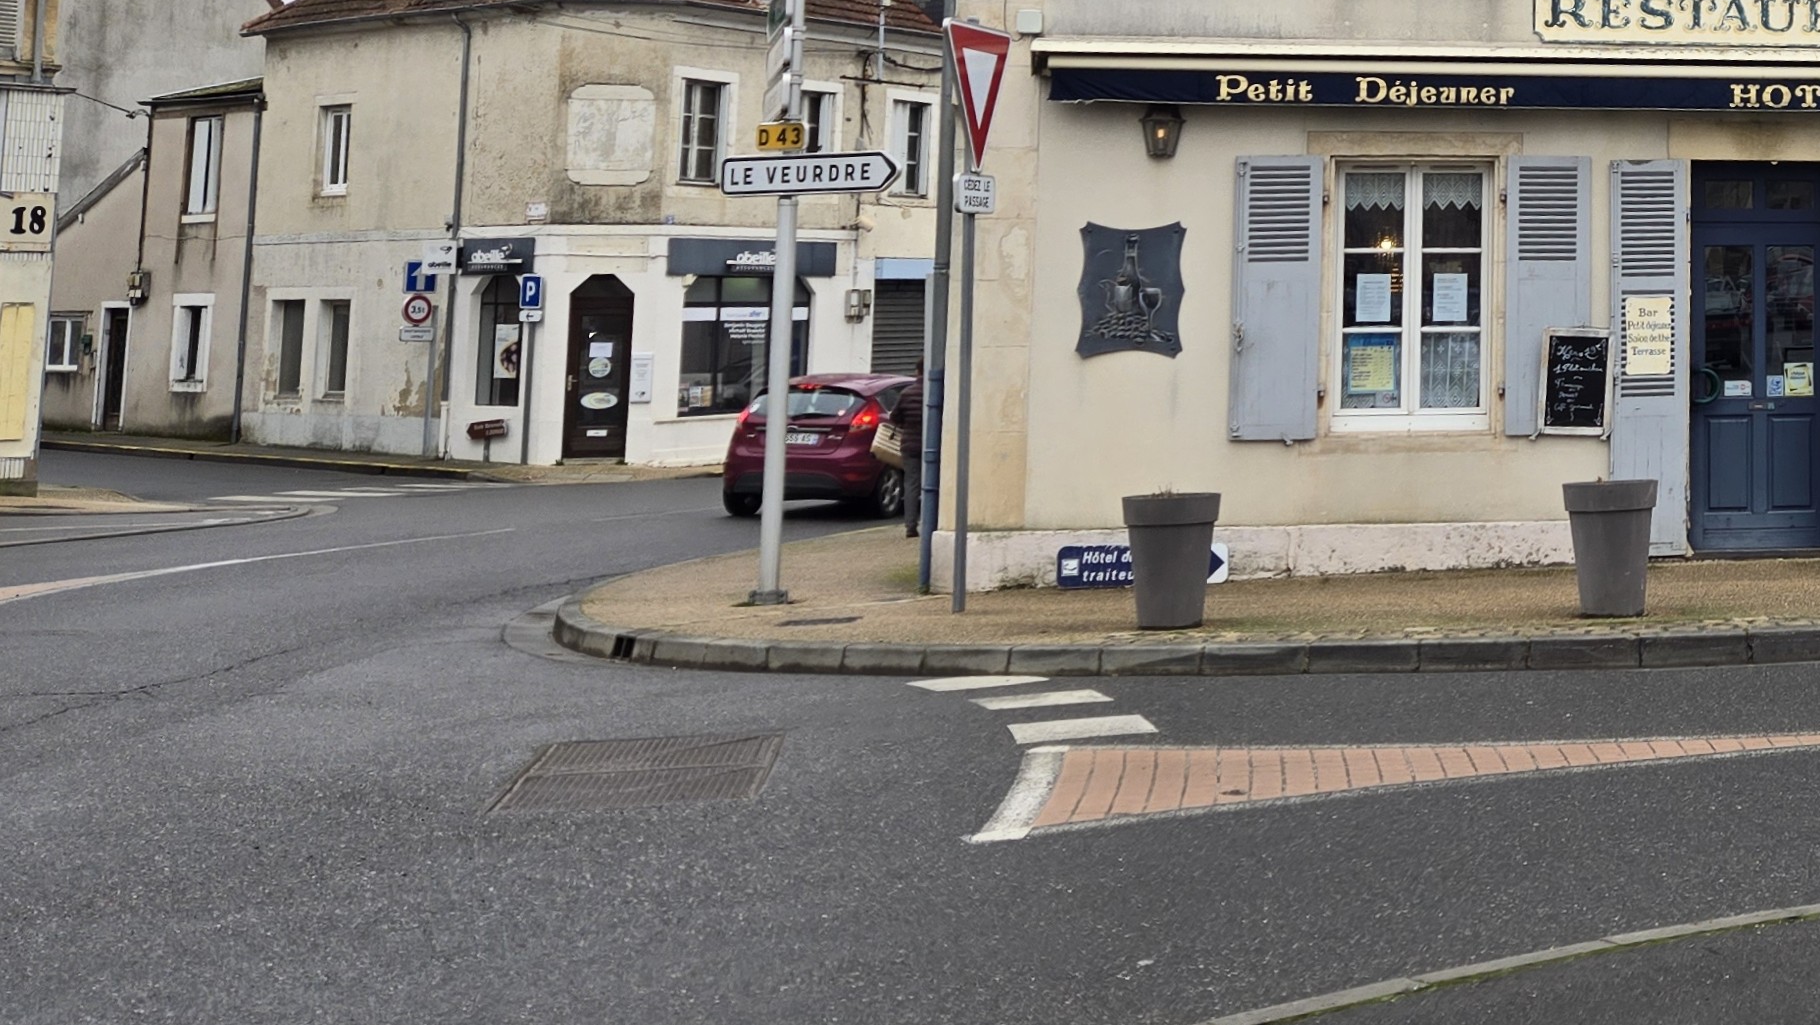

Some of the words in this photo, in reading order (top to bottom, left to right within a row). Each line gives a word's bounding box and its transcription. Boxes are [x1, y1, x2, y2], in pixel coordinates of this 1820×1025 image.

[1215, 74, 1313, 102] Petit
[1355, 76, 1515, 107] Déjeuner
[758, 128, 769, 146] D
[776, 127, 801, 145] 43
[730, 167, 753, 186] LE
[766, 163, 871, 185] VEURDRE
[984, 180, 991, 192] LE
[964, 195, 990, 208] PASSAGE
[10, 205, 47, 235] 18
[525, 281, 536, 302] P
[1638, 308, 1658, 317] Bar
[1627, 321, 1645, 330] Petit
[1630, 346, 1667, 356] Terrasse
[1082, 550, 1117, 564] Hôtel
